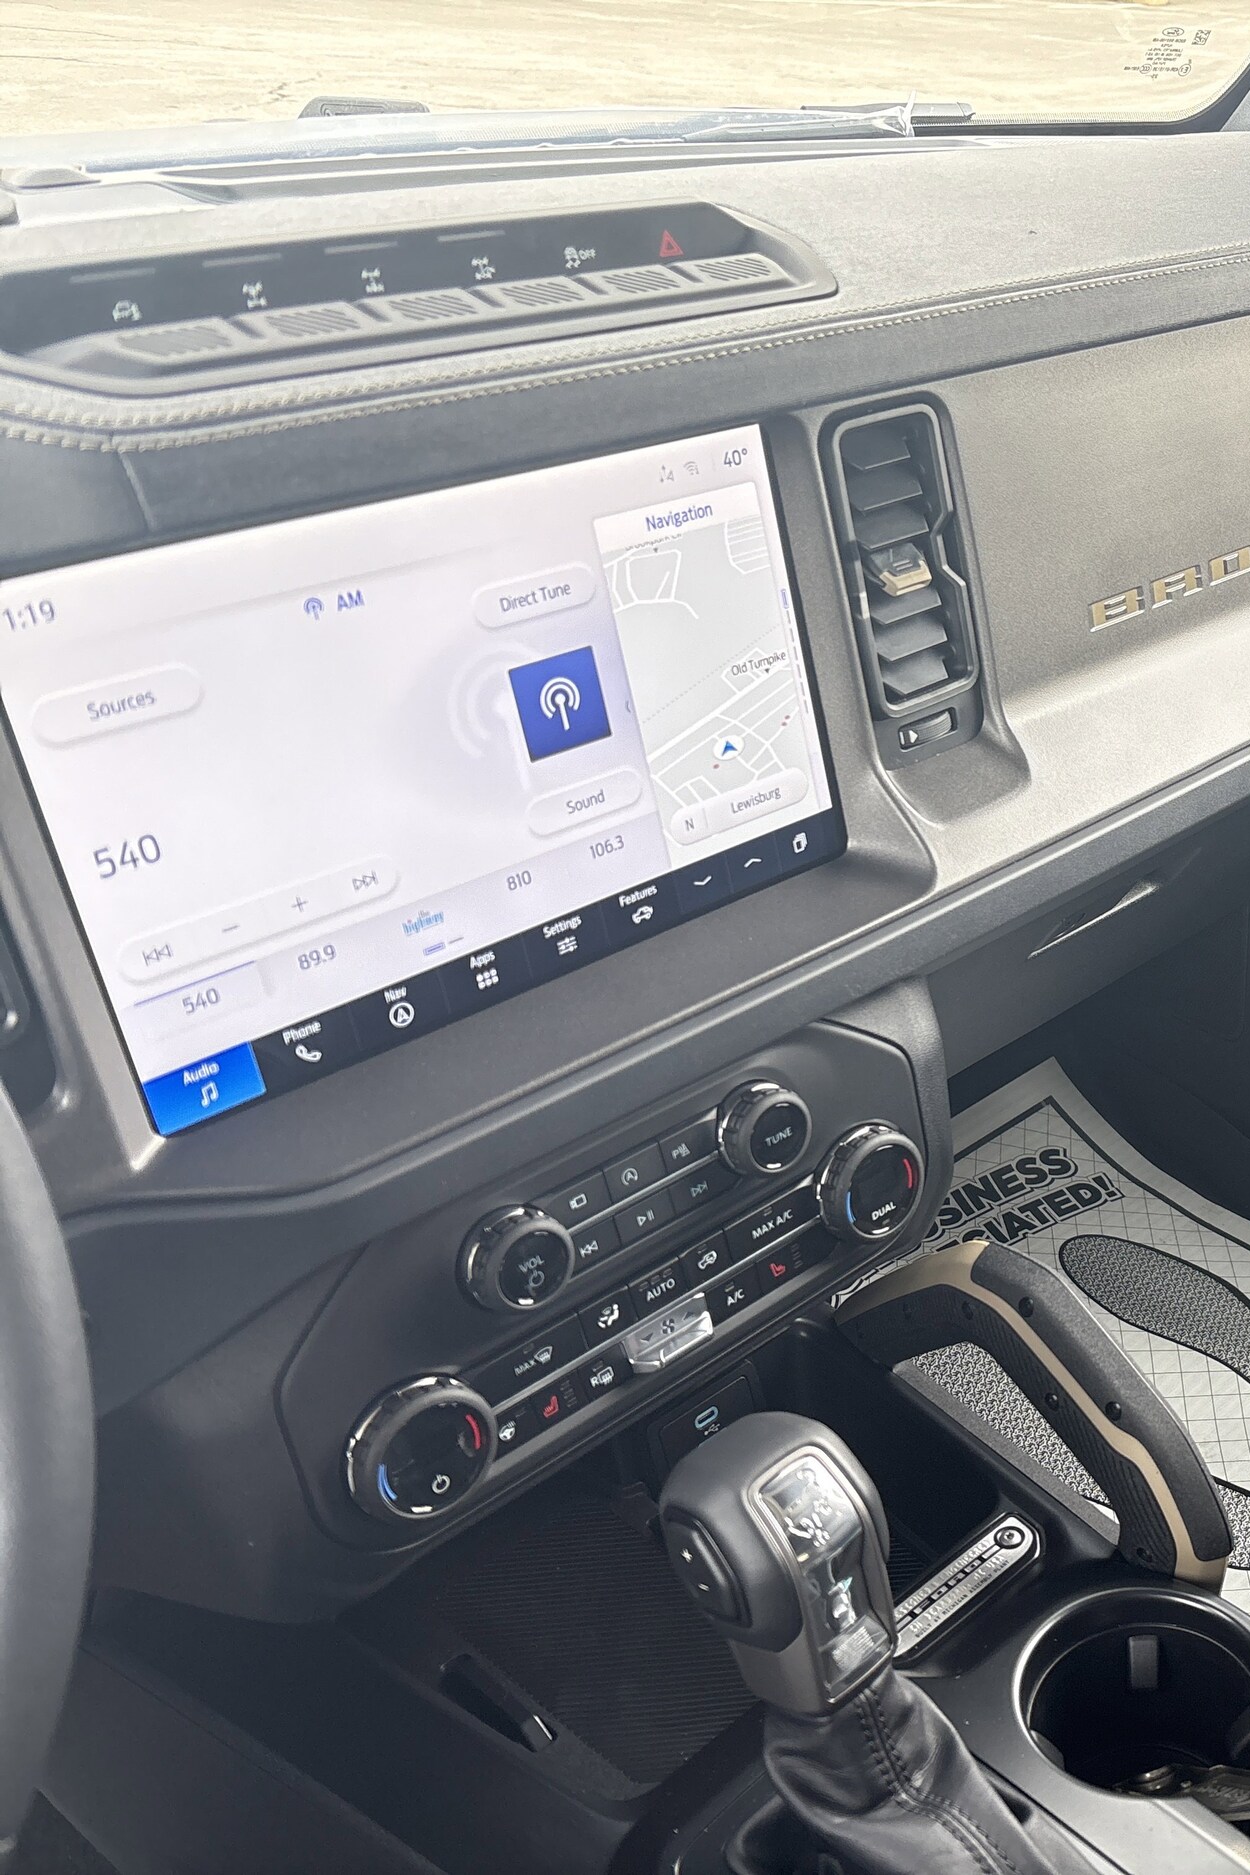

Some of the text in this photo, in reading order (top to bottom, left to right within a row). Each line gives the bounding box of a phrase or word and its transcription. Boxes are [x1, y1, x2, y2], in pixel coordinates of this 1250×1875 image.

[645, 503, 713, 532] Navigation
[337, 590, 365, 612] AM
[500, 582, 572, 613] Direct Tune
[1, 599, 57, 632] 1:19
[731, 651, 787, 677] Old Turnpike
[86, 689, 156, 722] Sources
[566, 789, 606, 815] Sound
[731, 786, 782, 815] Lewisburg
[685, 817, 695, 832] N
[93, 834, 162, 880] 540
[589, 835, 625, 860] 106.3
[506, 870, 533, 892] 810
[618, 884, 658, 908] Features
[543, 915, 582, 940] Settings
[297, 944, 337, 971] 89.9
[469, 951, 496, 970] Apps
[182, 988, 221, 1015] 540
[384, 985, 407, 1004] Nav
[283, 1020, 322, 1047] Phone
[183, 1061, 220, 1087] Audio
[765, 1126, 793, 1147] TUNE
[871, 1201, 897, 1222] DUAL
[751, 1209, 794, 1240] MAX A/C
[519, 1255, 545, 1274] VOL
[646, 1278, 676, 1302] AUTO
[726, 1289, 745, 1306] A/C
[514, 1359, 537, 1376] MAX
[986, 1556, 1006, 1568] USA
[913, 1559, 982, 1614] FORD
[915, 1560, 1010, 1638] BUILT AT MICHIGAN ASSEMBLY PLANT
